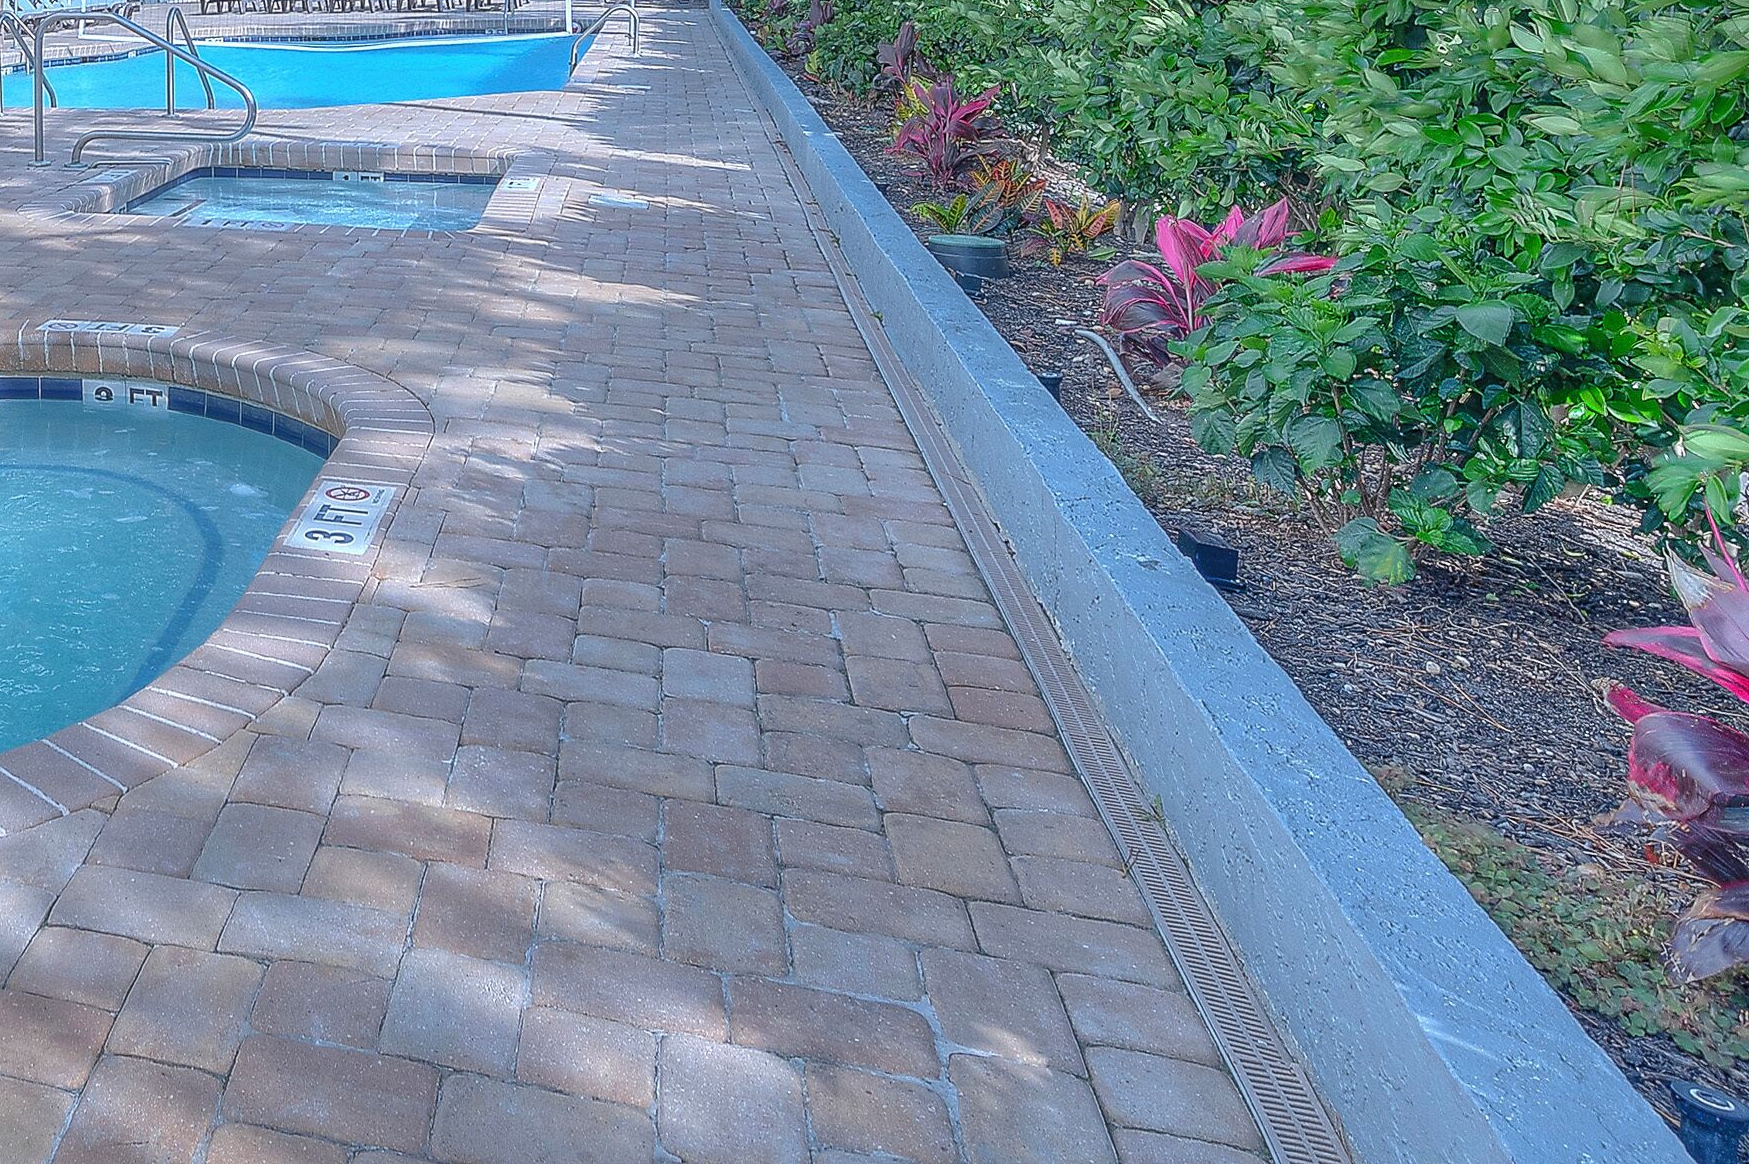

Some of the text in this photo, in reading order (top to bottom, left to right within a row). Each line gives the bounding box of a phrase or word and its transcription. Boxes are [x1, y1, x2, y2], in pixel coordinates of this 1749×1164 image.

[87, 323, 129, 331] FT
[129, 387, 163, 407] FT
[305, 504, 368, 544] 3 FT
